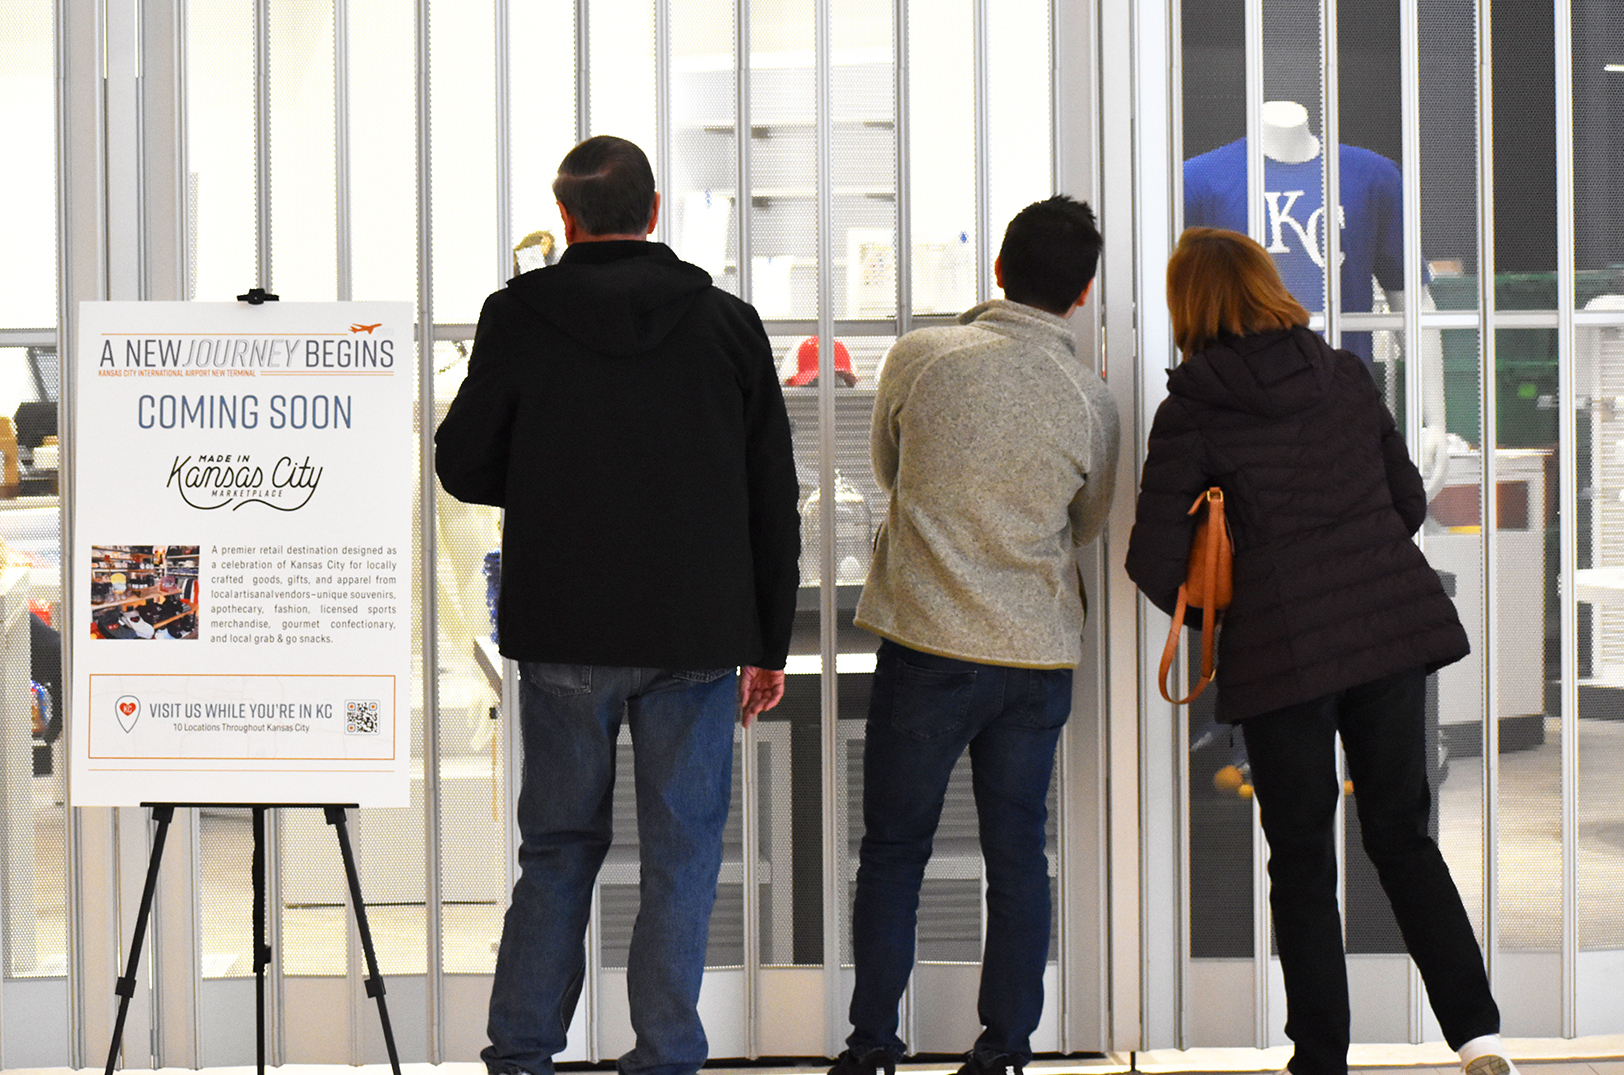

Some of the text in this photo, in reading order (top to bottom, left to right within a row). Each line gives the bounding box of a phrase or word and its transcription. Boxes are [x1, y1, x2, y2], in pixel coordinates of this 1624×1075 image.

[100, 339, 393, 368] A NEW JOURNEY BEGINS
[139, 395, 351, 429] COMING SOON
[167, 456, 323, 499] Kansas City
[212, 545, 218, 554] A
[222, 545, 255, 556] premier
[260, 546, 283, 554] retail
[287, 546, 338, 554] destination
[342, 546, 383, 556] designed
[221, 560, 272, 569] celebration
[277, 560, 286, 569] of
[291, 560, 322, 569] Kansas
[327, 560, 345, 571] City
[350, 560, 362, 569] for
[367, 561, 396, 571] locally
[211, 575, 396, 586] crafted goods, gifts, and apparel from
[350, 590, 396, 599] souvenirs,
[211, 604, 396, 615] apothecary, fashion, licensed sports
[211, 619, 395, 630] merchandise, gourmet confectionary,
[210, 634, 333, 645] and local grab & go snacks.
[150, 704, 332, 718] VISIT US WHILE YOU'RE IN KC
[174, 723, 309, 733] 10 Locations Throughout Kansas City
